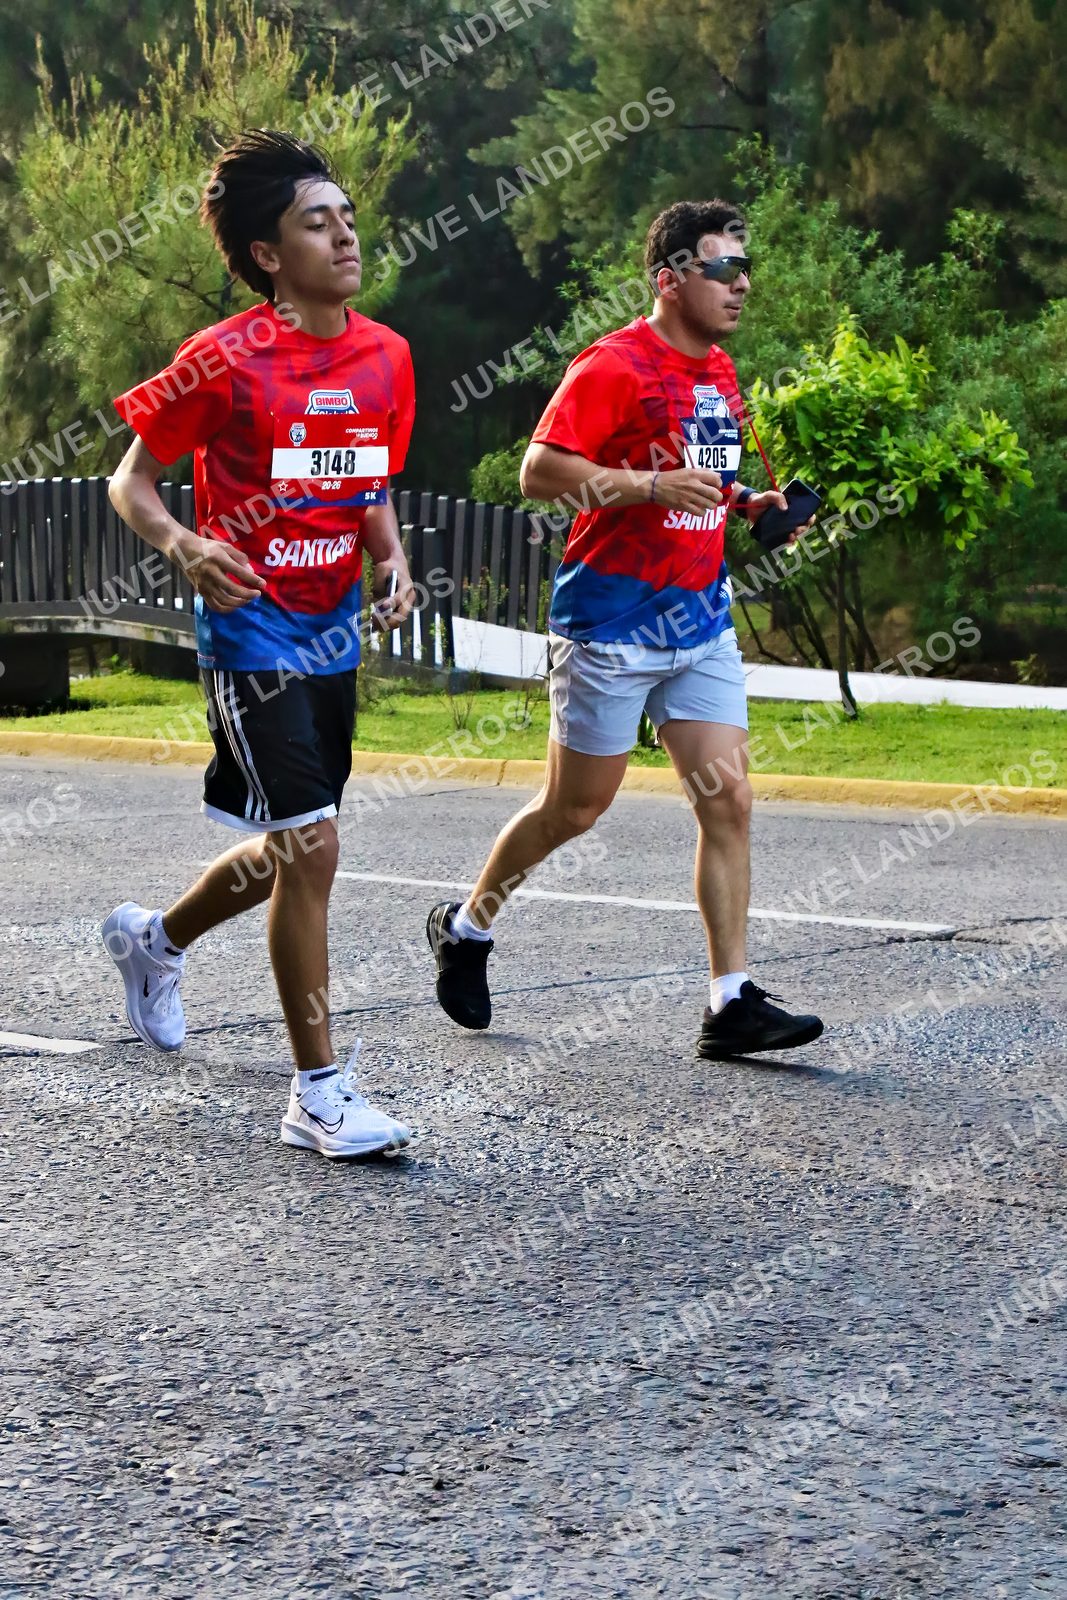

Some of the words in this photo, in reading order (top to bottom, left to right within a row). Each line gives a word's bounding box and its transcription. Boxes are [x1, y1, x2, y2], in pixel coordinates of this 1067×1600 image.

[315, 397, 348, 406] BIMBO
[310, 449, 356, 476] 3148
[698, 447, 727, 469] 4205
